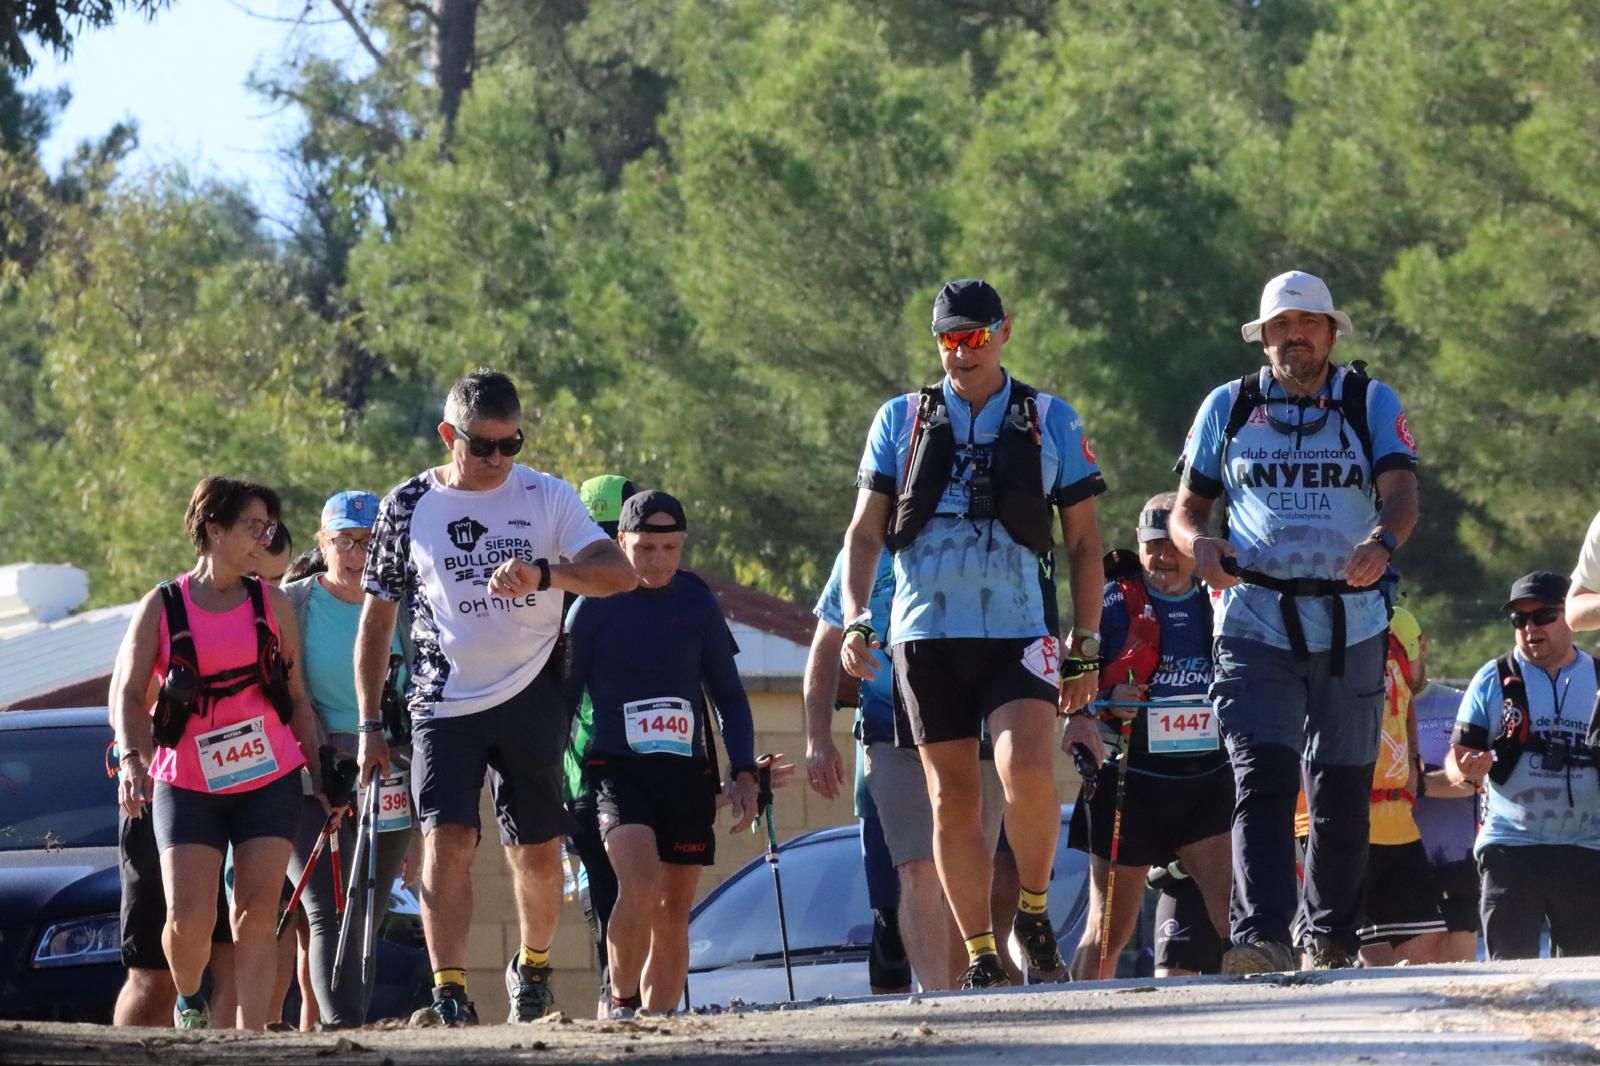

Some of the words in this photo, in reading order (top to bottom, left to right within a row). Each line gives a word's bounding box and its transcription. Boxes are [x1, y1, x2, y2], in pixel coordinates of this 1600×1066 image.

[1241, 448, 1267, 460] club
[1271, 448, 1289, 460] de
[1293, 448, 1356, 460] montaña
[1236, 463, 1363, 489] ANYERA
[1266, 492, 1331, 511] CEUTA
[485, 538, 532, 550] SIERRA
[444, 548, 533, 571] BULLONES
[1149, 669, 1211, 687] BULLON
[638, 715, 688, 735] 1440
[1160, 712, 1211, 732] 1447
[1536, 716, 1551, 727] de
[212, 738, 265, 767] 1445
[383, 792, 407, 811] 396
